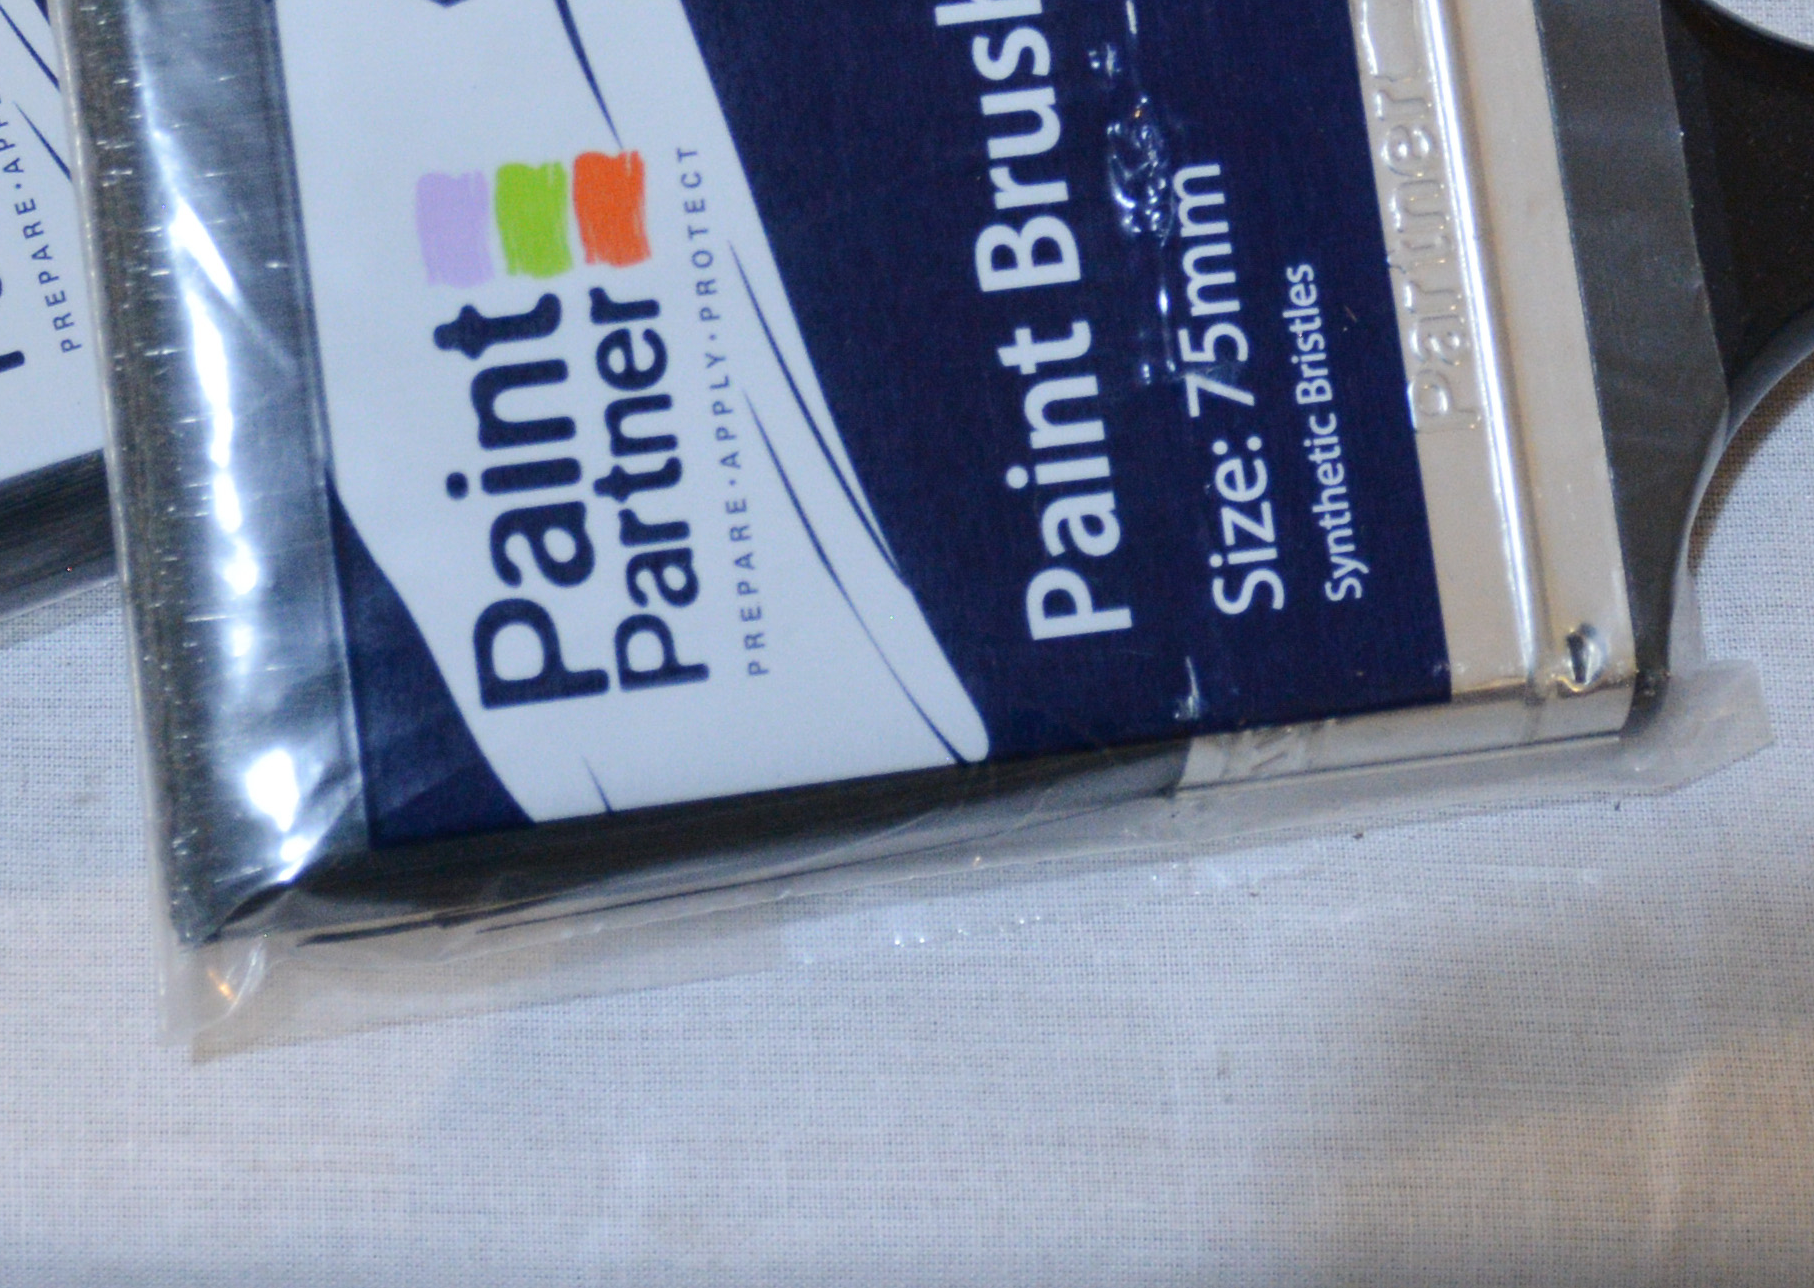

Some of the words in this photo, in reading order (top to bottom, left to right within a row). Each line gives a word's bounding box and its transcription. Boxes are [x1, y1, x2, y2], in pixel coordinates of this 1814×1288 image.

[1172, 163, 1255, 418] 75mm
[1284, 262, 1335, 406] Bristles
[433, 293, 610, 709] Paint
[589, 287, 709, 690] Partner
[998, 320, 1132, 641] Paint
[1209, 434, 1284, 614] Size:
[1304, 411, 1371, 603] Synthetic
